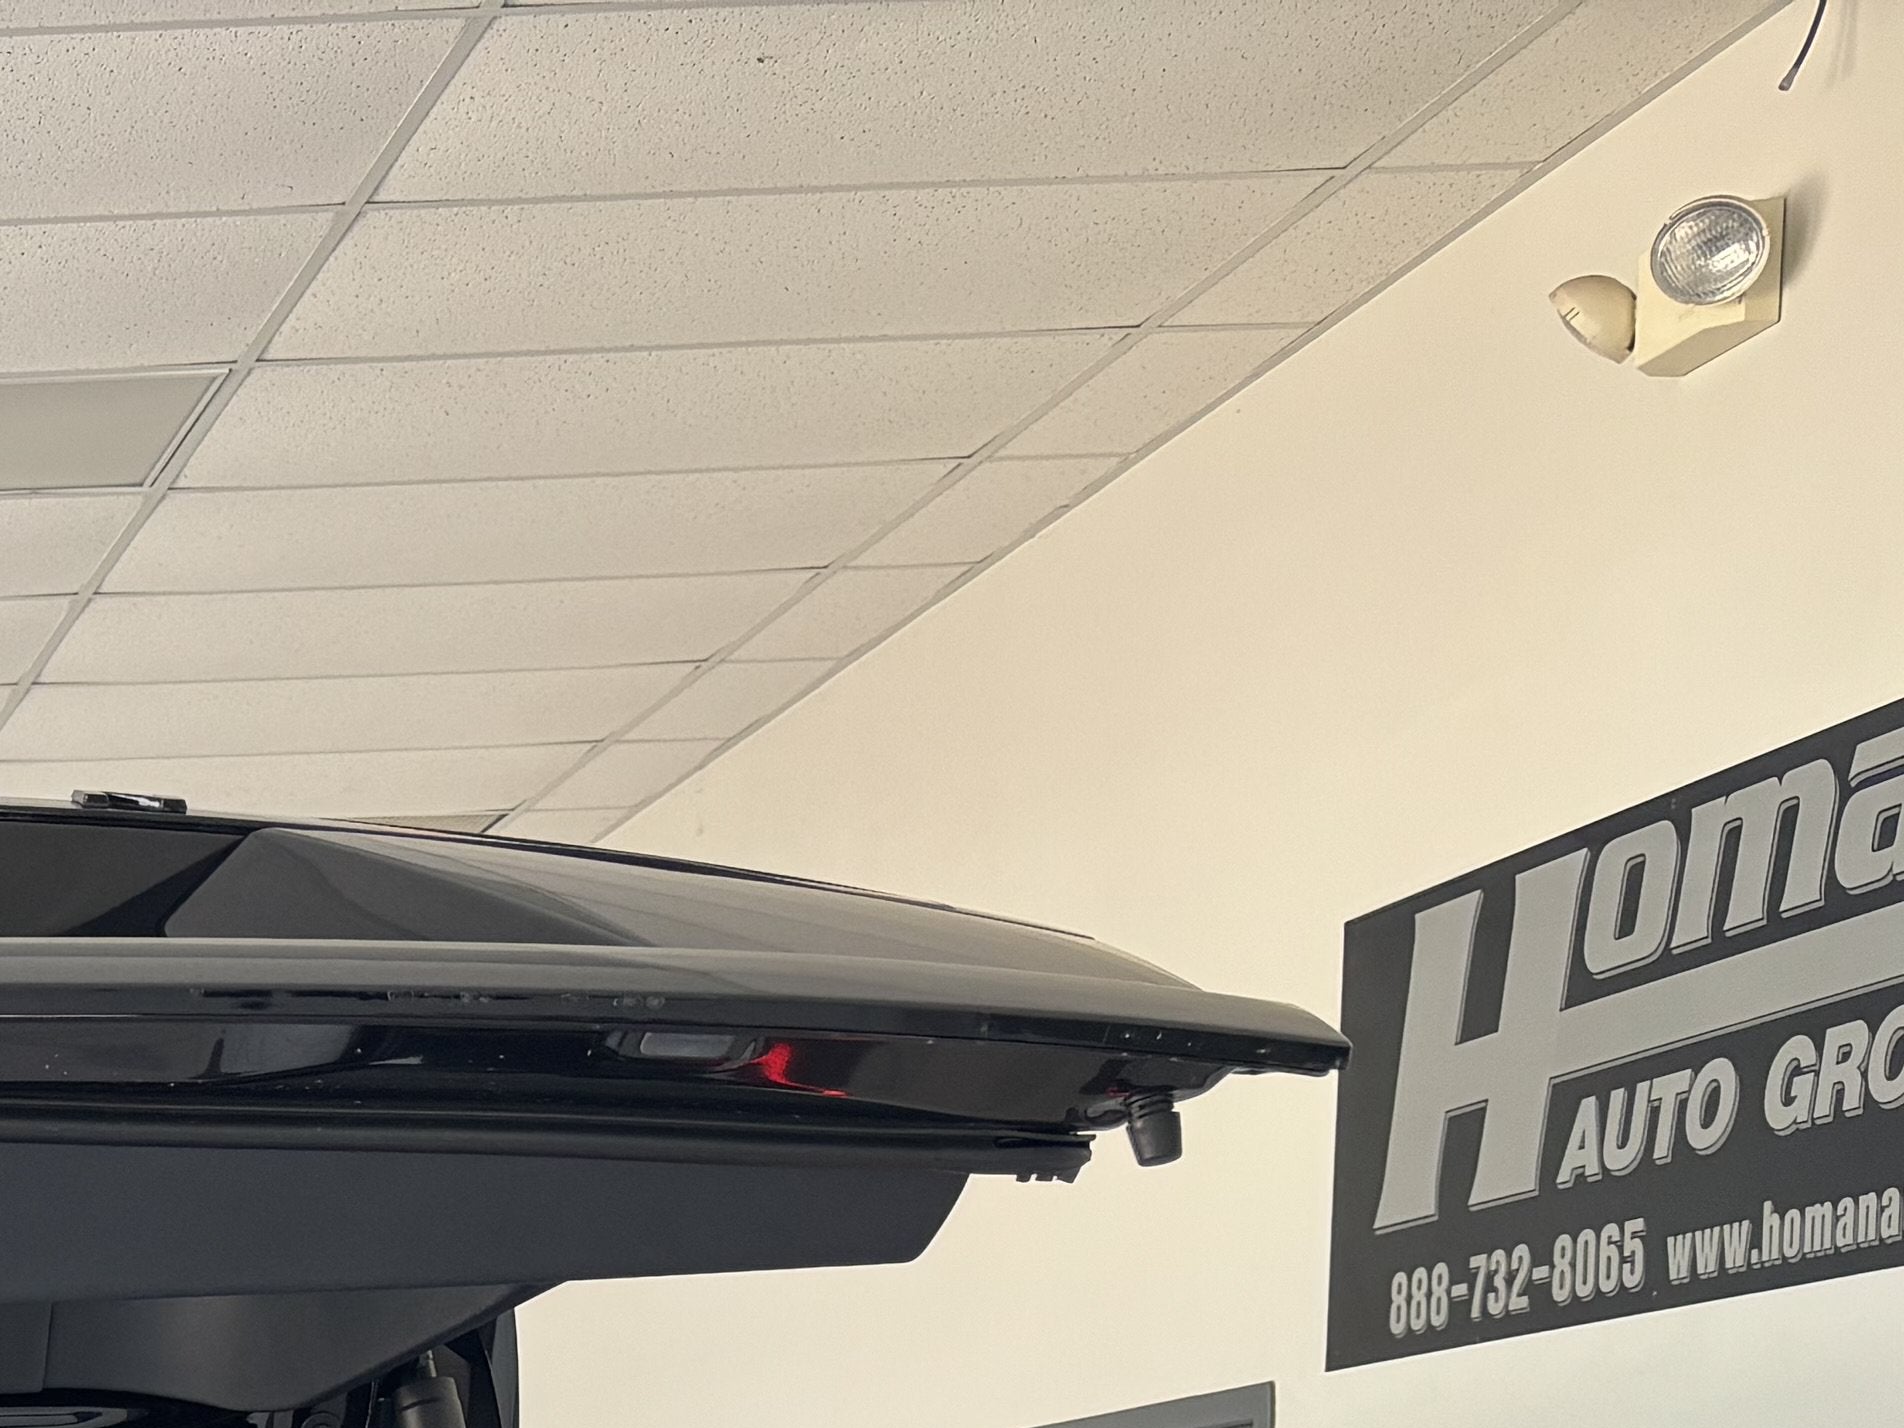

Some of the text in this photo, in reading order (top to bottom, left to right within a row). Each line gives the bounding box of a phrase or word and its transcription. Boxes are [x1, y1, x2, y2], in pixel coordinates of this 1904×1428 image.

[1556, 1056, 1740, 1190] AUTO
[1390, 1187, 1903, 1337] 888-732-8065 www.homana
